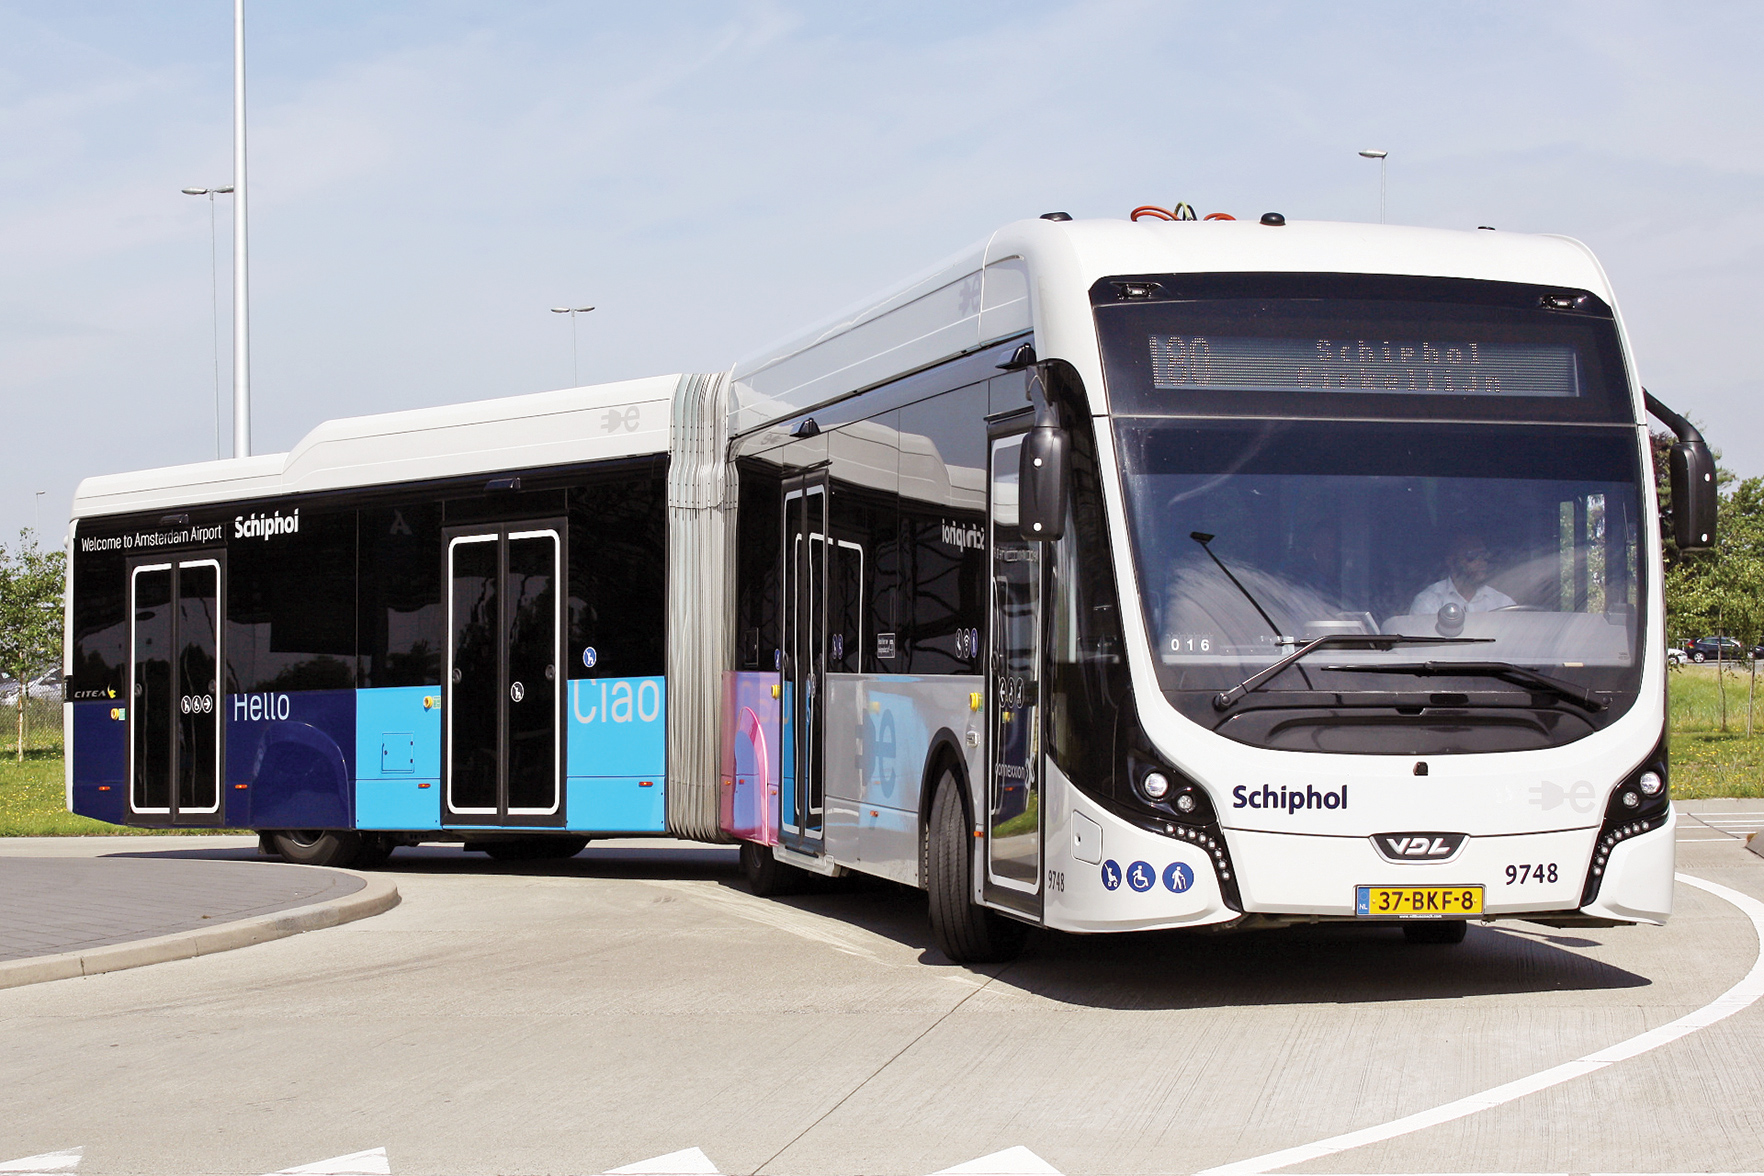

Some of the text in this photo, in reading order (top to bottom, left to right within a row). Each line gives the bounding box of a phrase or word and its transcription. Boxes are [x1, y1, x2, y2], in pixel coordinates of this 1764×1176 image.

[1317, 339, 1480, 364] Schiphol
[1297, 367, 1500, 392] Cirkellijn
[234, 508, 299, 541] Schiphol
[81, 525, 222, 552] Welcome to Amsterdam Airport
[74, 690, 107, 699] CITEA
[234, 692, 290, 722] Hello
[574, 678, 660, 724] Ciao
[1232, 783, 1348, 815] Schiphol
[1386, 837, 1451, 856] VDL
[1048, 870, 1065, 892] 9748
[1505, 863, 1558, 885] 9748
[1378, 891, 1474, 911] 37-BKF-8
